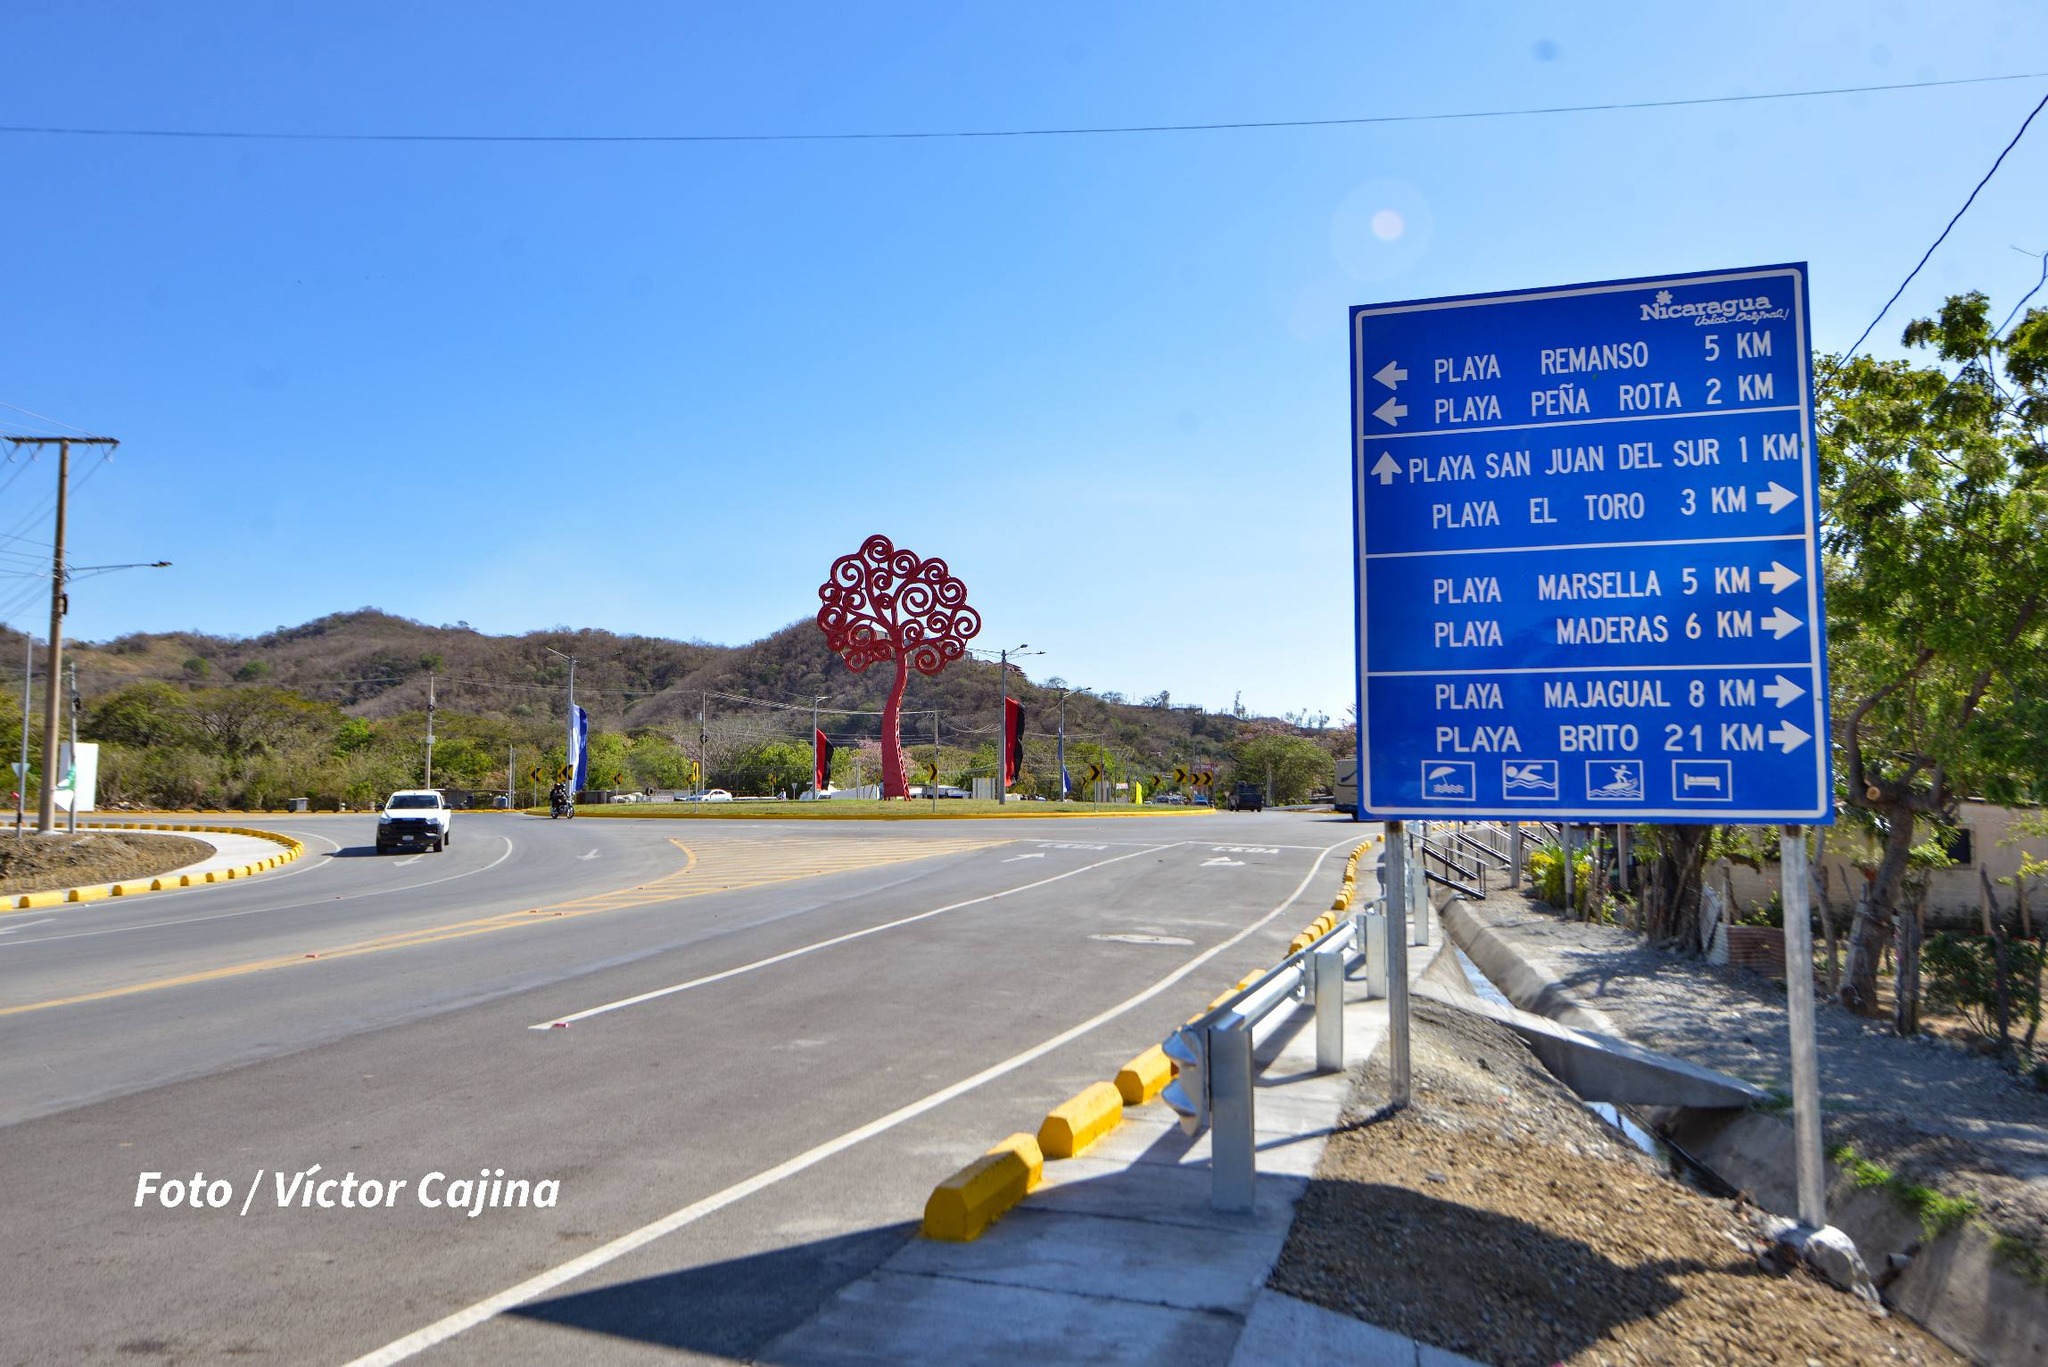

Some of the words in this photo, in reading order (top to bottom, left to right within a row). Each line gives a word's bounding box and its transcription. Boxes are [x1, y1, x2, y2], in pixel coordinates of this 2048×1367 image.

[1639, 296, 1772, 321] Nicaragua
[1435, 354, 1501, 384] PLAYA
[1541, 341, 1649, 375] REMANSO
[1705, 334, 1720, 362] 5
[1737, 330, 1772, 359] KM
[1435, 395, 1502, 424] PLAYA
[1531, 382, 1591, 417] PEÑA
[1619, 382, 1682, 411] ROTA
[1706, 378, 1722, 405] 2
[1738, 373, 1774, 402] KM
[1409, 455, 1476, 483] PLAYA
[1485, 450, 1531, 479] SAN
[1544, 445, 1604, 475] JUAN
[1618, 442, 1662, 470] DEL
[1673, 438, 1720, 467] SUR
[1739, 436, 1748, 463] 1
[1762, 433, 1799, 461] KM
[1433, 500, 1500, 529] PLAYA
[1530, 497, 1557, 524] EL
[1584, 492, 1645, 521] TORO
[1680, 488, 1696, 516] 3
[1711, 485, 1747, 514] KM
[1434, 576, 1502, 604] PLAYA
[1538, 570, 1662, 601] MARSELLA
[1682, 567, 1698, 595] 5
[1714, 566, 1751, 594] KM
[1434, 620, 1503, 648] PLAYA
[1557, 614, 1669, 645] MADERAS
[1685, 612, 1702, 639] 6
[1717, 610, 1753, 638] KM
[1435, 683, 1503, 710] PLAYA
[1544, 680, 1671, 708] MAJAGUAL
[1689, 679, 1705, 708] 8
[1719, 679, 1756, 707] KM
[1436, 726, 1522, 753] PLAYA
[1559, 724, 1639, 752] BRITO
[1664, 723, 1702, 752] 21
[1721, 723, 1764, 751] KM
